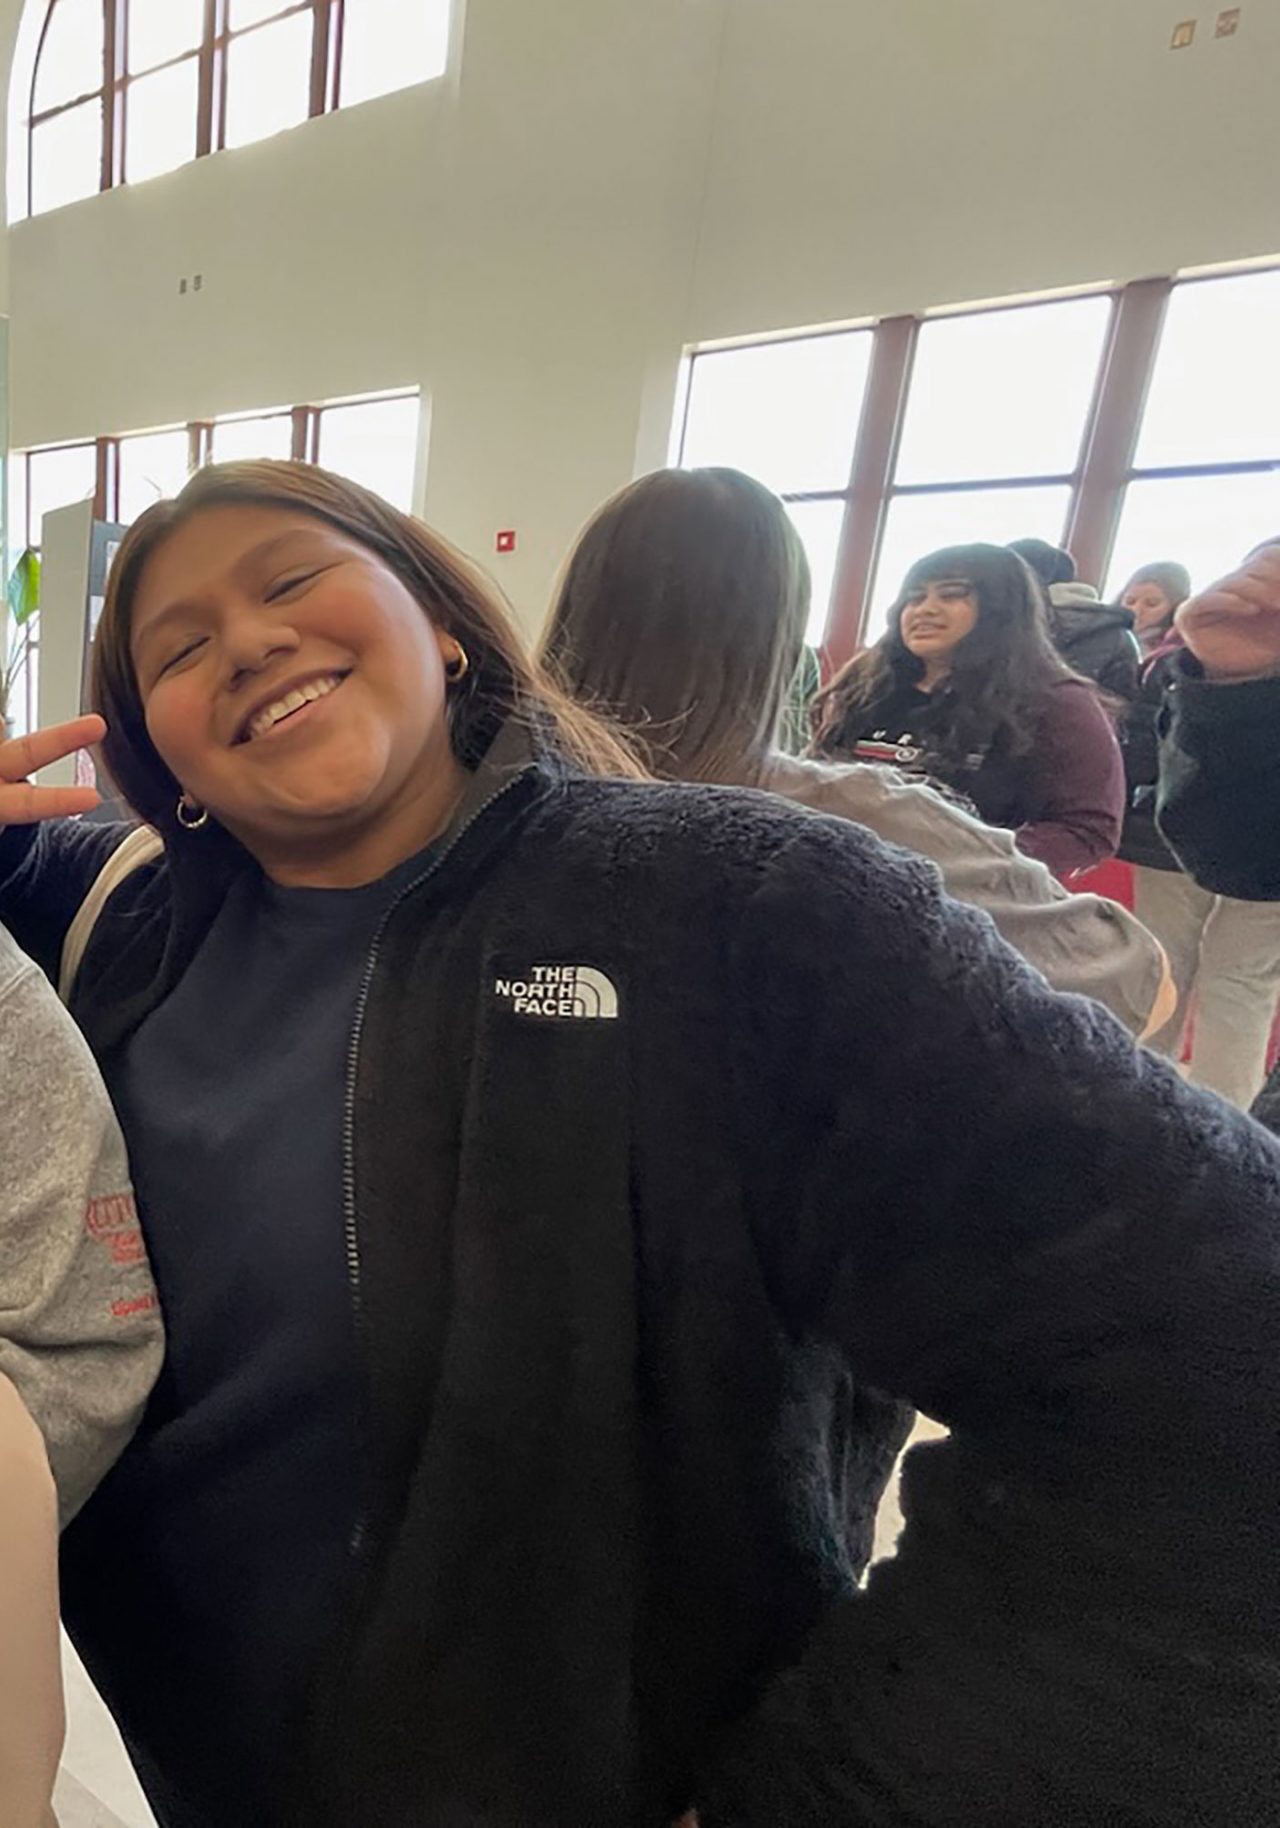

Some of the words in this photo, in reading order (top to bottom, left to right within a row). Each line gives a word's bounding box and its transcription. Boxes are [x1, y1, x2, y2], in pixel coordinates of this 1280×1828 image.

[532, 966, 576, 982] THE
[495, 979, 573, 998] NORTH
[514, 998, 572, 1016] FACE
